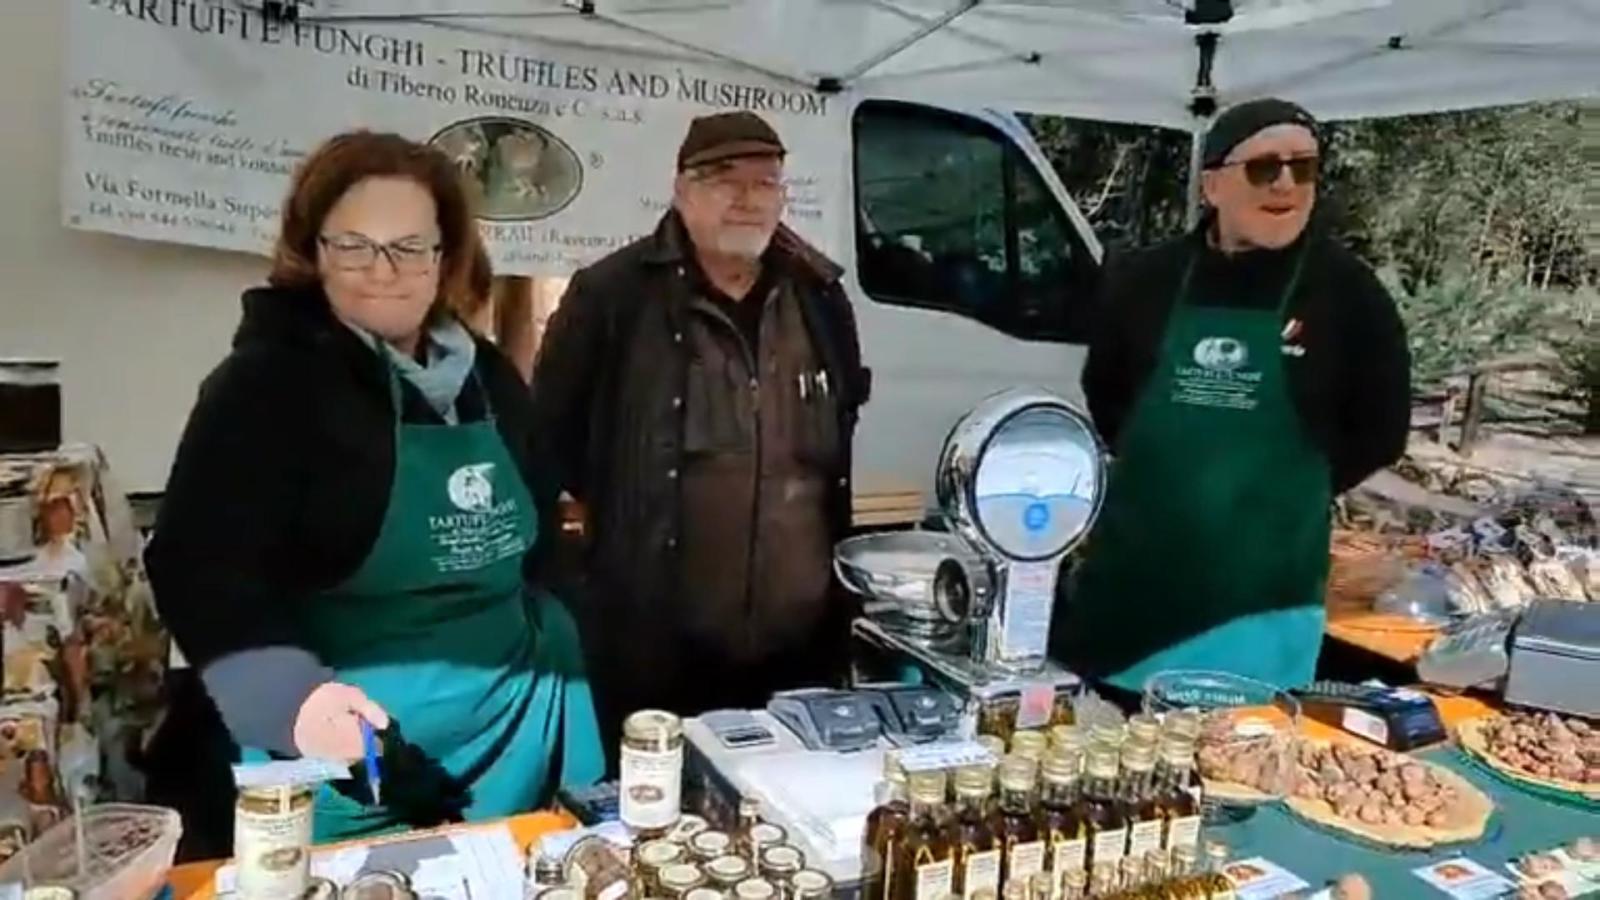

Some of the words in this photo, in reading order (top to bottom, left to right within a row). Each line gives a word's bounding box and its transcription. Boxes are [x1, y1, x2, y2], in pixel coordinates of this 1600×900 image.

[90, 0, 248, 40] ARTUFI
[294, 20, 424, 66] FUNGHI
[459, 50, 598, 92] TRUFFLES
[605, 66, 671, 99] AND
[677, 74, 828, 116] MUSHROOM
[346, 64, 369, 89] di
[377, 70, 457, 103] Tiberio
[84, 171, 119, 197] Via
[126, 179, 217, 211] Formella
